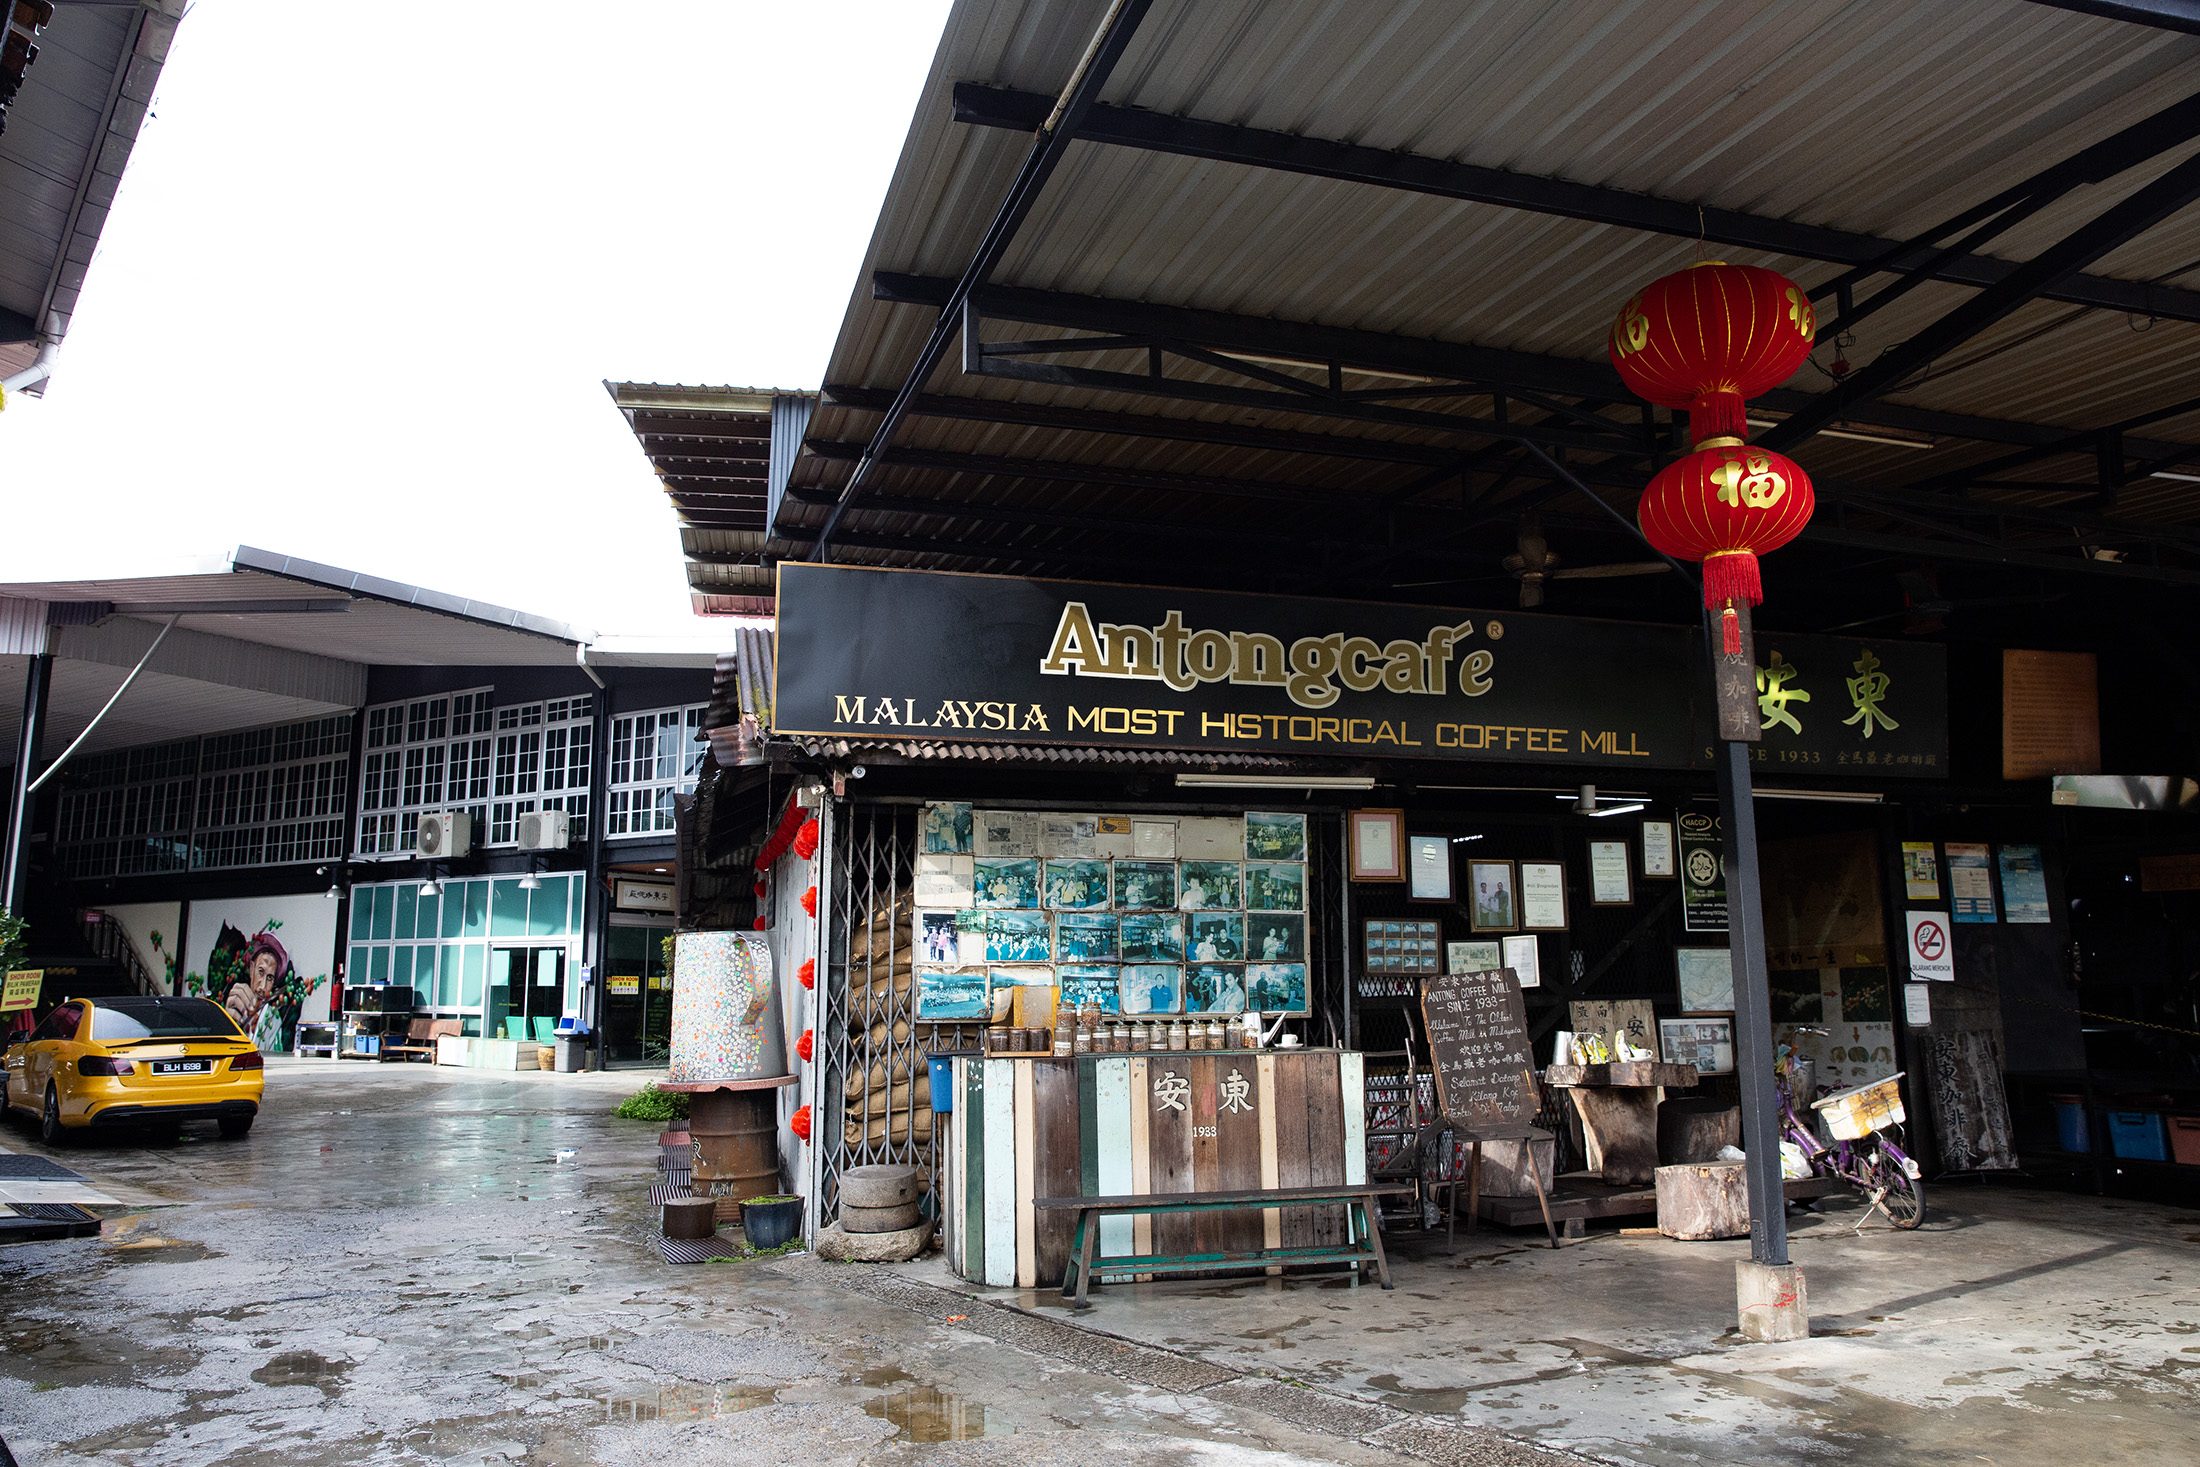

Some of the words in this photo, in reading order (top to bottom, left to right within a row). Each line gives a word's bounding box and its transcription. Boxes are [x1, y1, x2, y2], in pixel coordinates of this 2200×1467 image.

[1710, 451, 1786, 509] 福
[833, 695, 1051, 732] MALAYSIA
[1068, 706, 1185, 736] MOST
[1201, 712, 1422, 747] HISTORICAL
[1436, 723, 1569, 753] COFFEE
[1580, 731, 1650, 756] MILL
[1779, 751, 1821, 764] 1933
[1685, 818, 1707, 826] HACCP
[1766, 950, 1837, 966] 啡的一生
[1912, 964, 1932, 972] DILARANG
[1932, 964, 1952, 972] MEROKOK
[9, 973, 26, 981] SHOW
[1428, 989, 1457, 1003] ANTONG
[1460, 985, 1487, 999] COFFEE
[1491, 982, 1512, 995] MILL
[1475, 996, 1498, 1010] 1933
[1430, 1019, 1459, 1031] Welcome
[1464, 1016, 1473, 1026] To
[1475, 1014, 1487, 1025] The
[1489, 1011, 1514, 1024] Oldest
[1433, 1031, 1455, 1044] Coffee
[1459, 1029, 1475, 1041] Mill
[163, 1063, 181, 1072] BLH
[182, 1062, 202, 1071] 1698
[1450, 1076, 1486, 1090] Selamat
[1490, 1072, 1521, 1088] Datang
[1154, 1069, 1255, 1114] 安東
[1192, 1126, 1217, 1138] 1933
